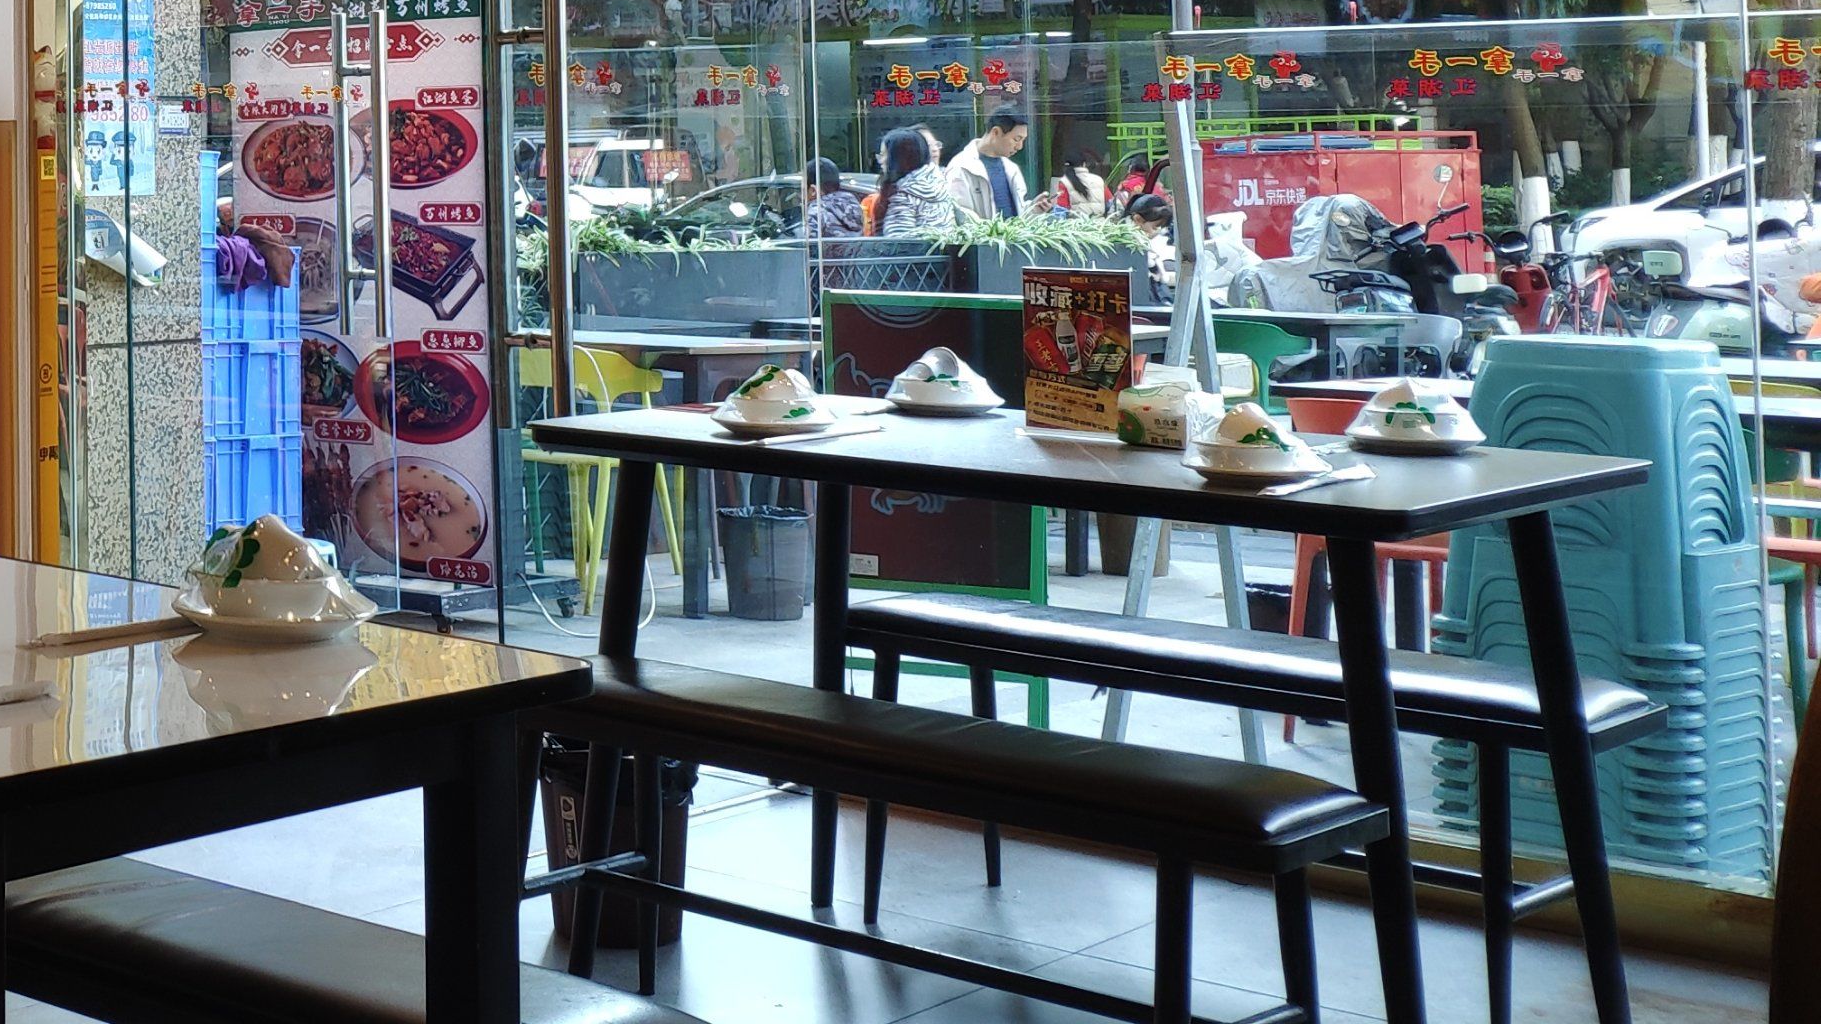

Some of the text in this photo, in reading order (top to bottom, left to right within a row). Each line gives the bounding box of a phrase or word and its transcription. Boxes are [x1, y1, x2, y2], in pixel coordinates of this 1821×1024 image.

[1233, 178, 1265, 207] JDL
[1265, 187, 1307, 205] 京东快递
